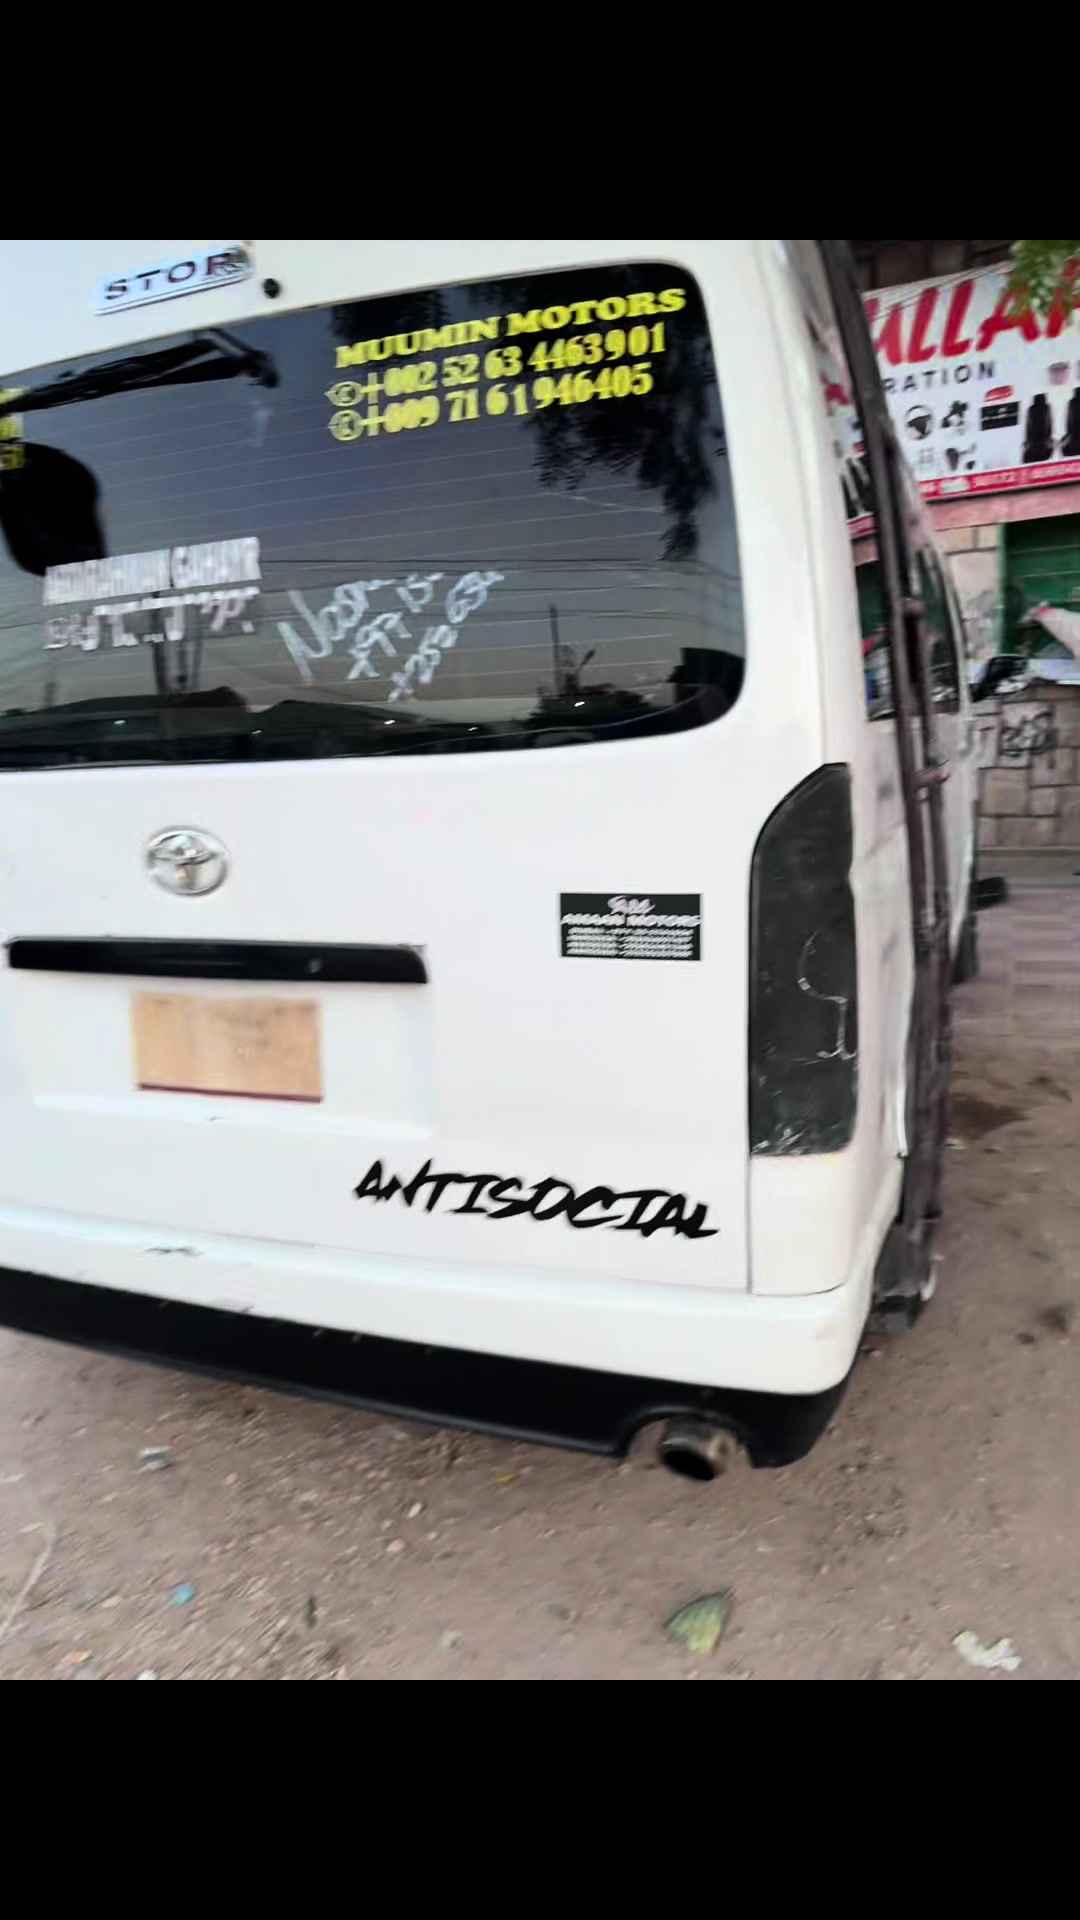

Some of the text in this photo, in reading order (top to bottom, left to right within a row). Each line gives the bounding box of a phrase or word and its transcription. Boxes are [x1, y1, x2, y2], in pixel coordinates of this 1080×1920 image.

[335, 288, 687, 368] MUUMIN MOTORS
[441, 353, 480, 387] 52
[484, 346, 524, 380] 63
[528, 322, 667, 372] 4463901
[444, 387, 481, 422] 71
[531, 361, 654, 410] 946405
[352, 1158, 721, 1240] ANTISOCIAL
